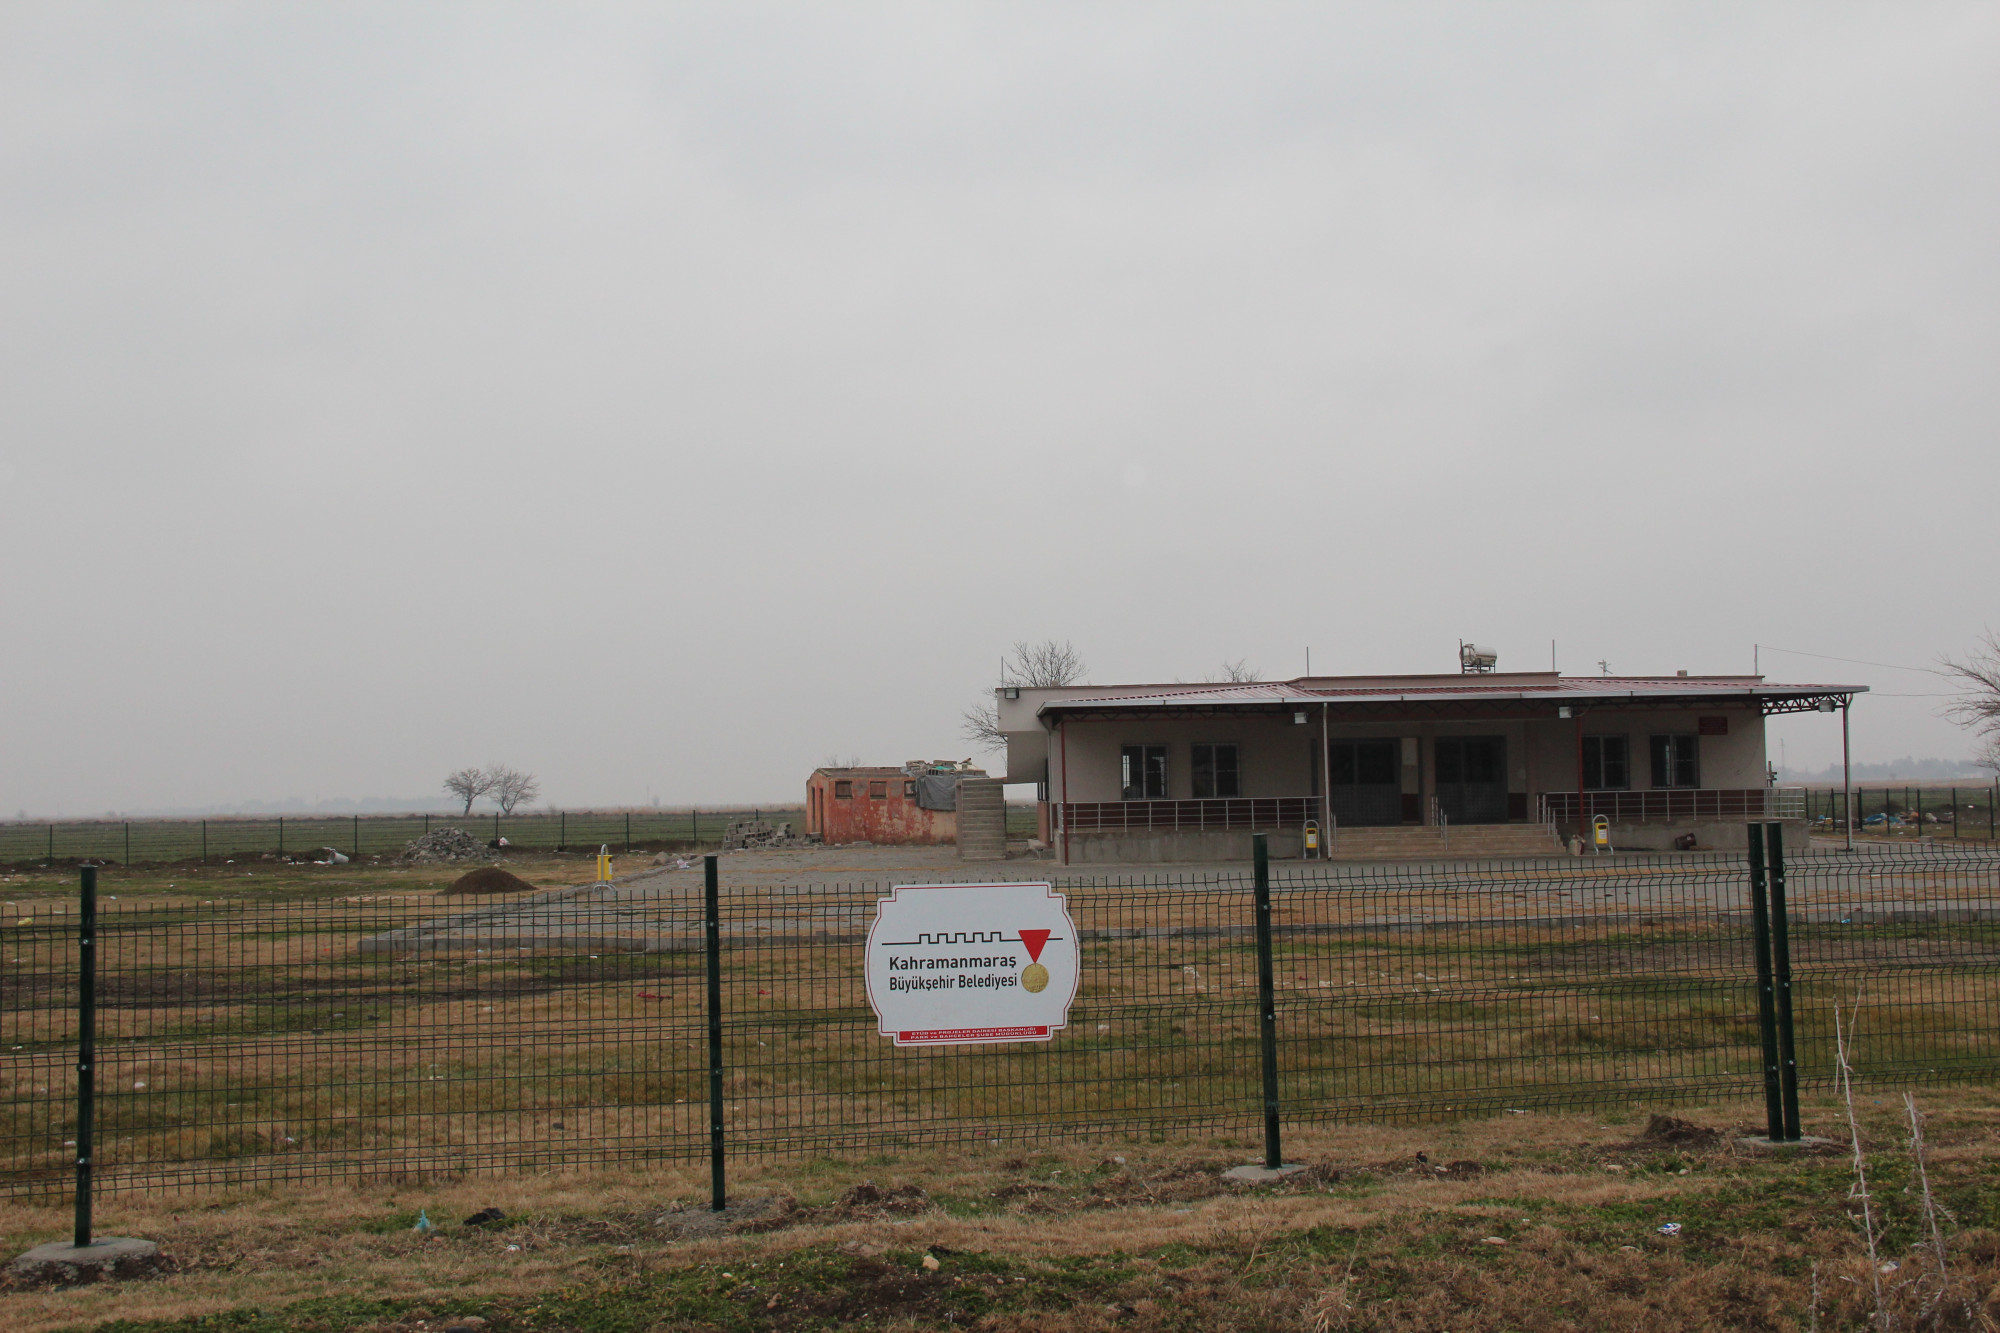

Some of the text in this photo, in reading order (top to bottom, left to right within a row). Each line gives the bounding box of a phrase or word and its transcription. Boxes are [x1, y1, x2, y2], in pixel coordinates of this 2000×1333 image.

[889, 956, 1017, 970] Kahramanmaraş
[889, 973, 1018, 993] Büyükşehir Belediyesi
